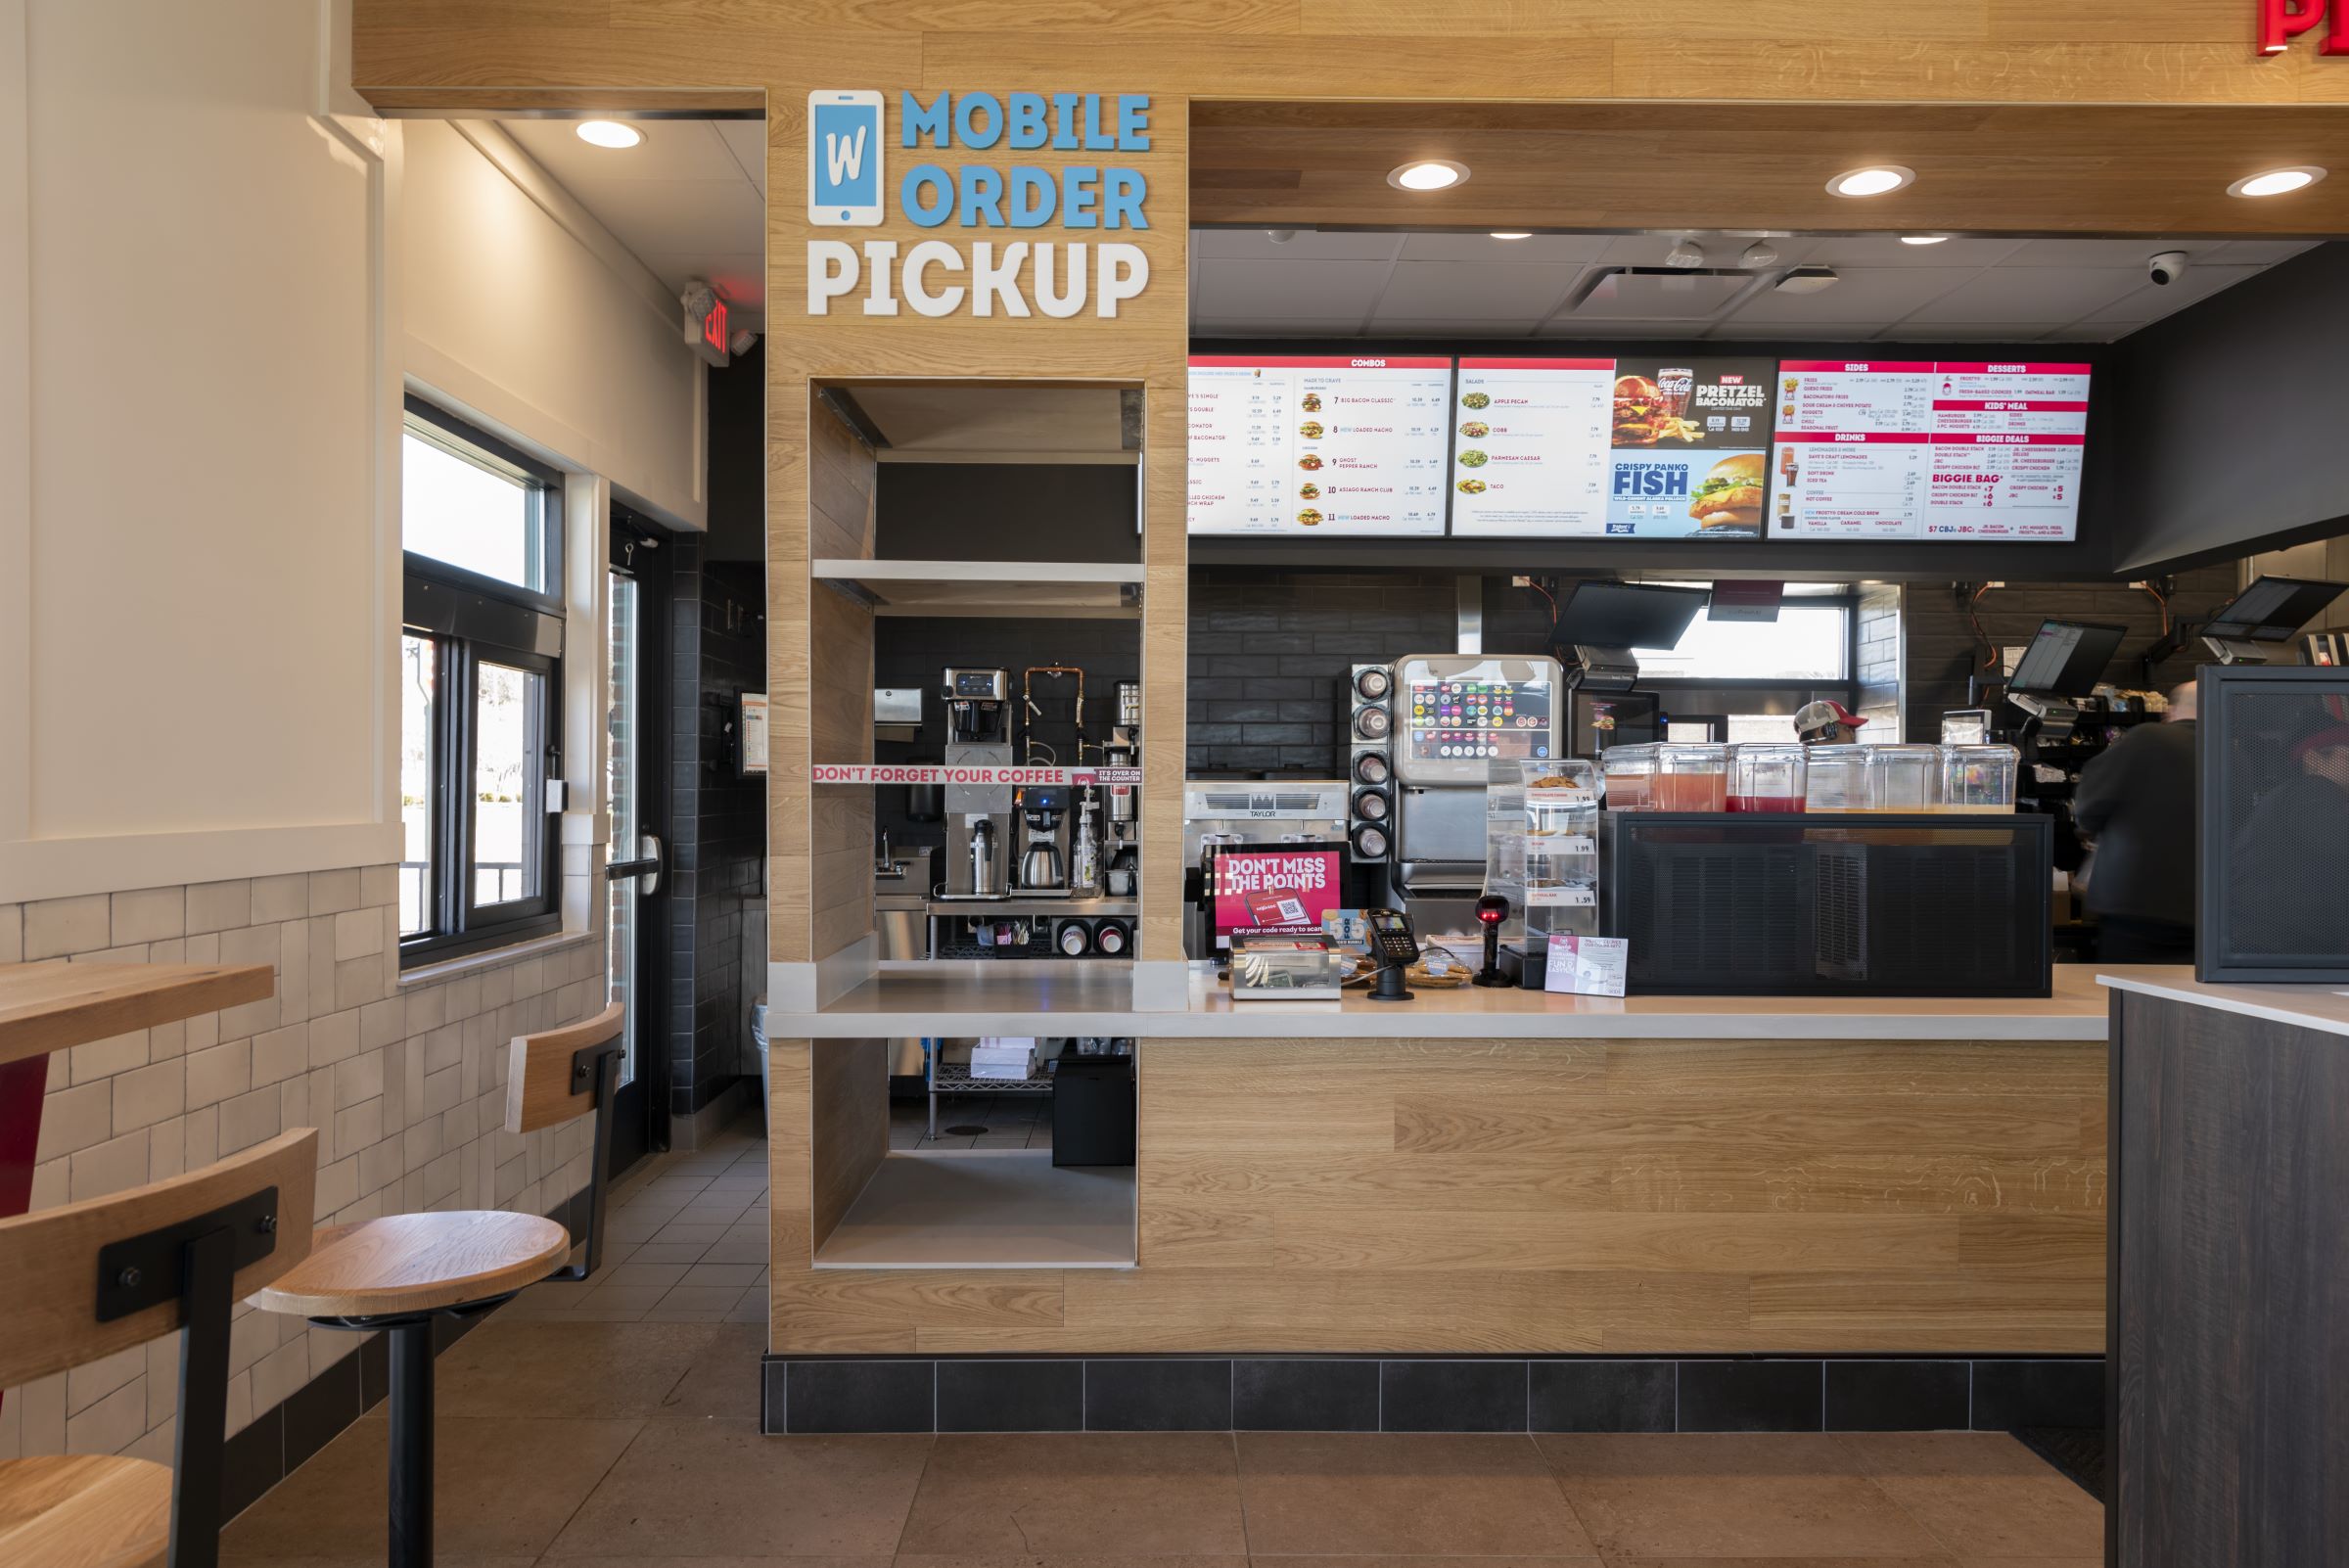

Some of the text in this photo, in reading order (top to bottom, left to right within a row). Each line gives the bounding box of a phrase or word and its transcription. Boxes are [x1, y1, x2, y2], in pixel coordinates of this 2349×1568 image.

[901, 90, 1150, 150] MOBILE
[826, 124, 867, 187] W
[901, 164, 1149, 230] ORDER
[807, 240, 1149, 318] PICKUP
[1659, 378, 1692, 392] Coca-Cola
[1696, 385, 1765, 397] PRETZEL
[1696, 397, 1763, 407] BACONATOR
[1614, 470, 1688, 495] FISH
[1933, 475, 1972, 483] BIGGIE
[813, 767, 1063, 783] DON'T FORGET YOUR COFFEE
[1229, 858, 1325, 874] DON'T MISS
[1231, 873, 1325, 890] THE POINTS
